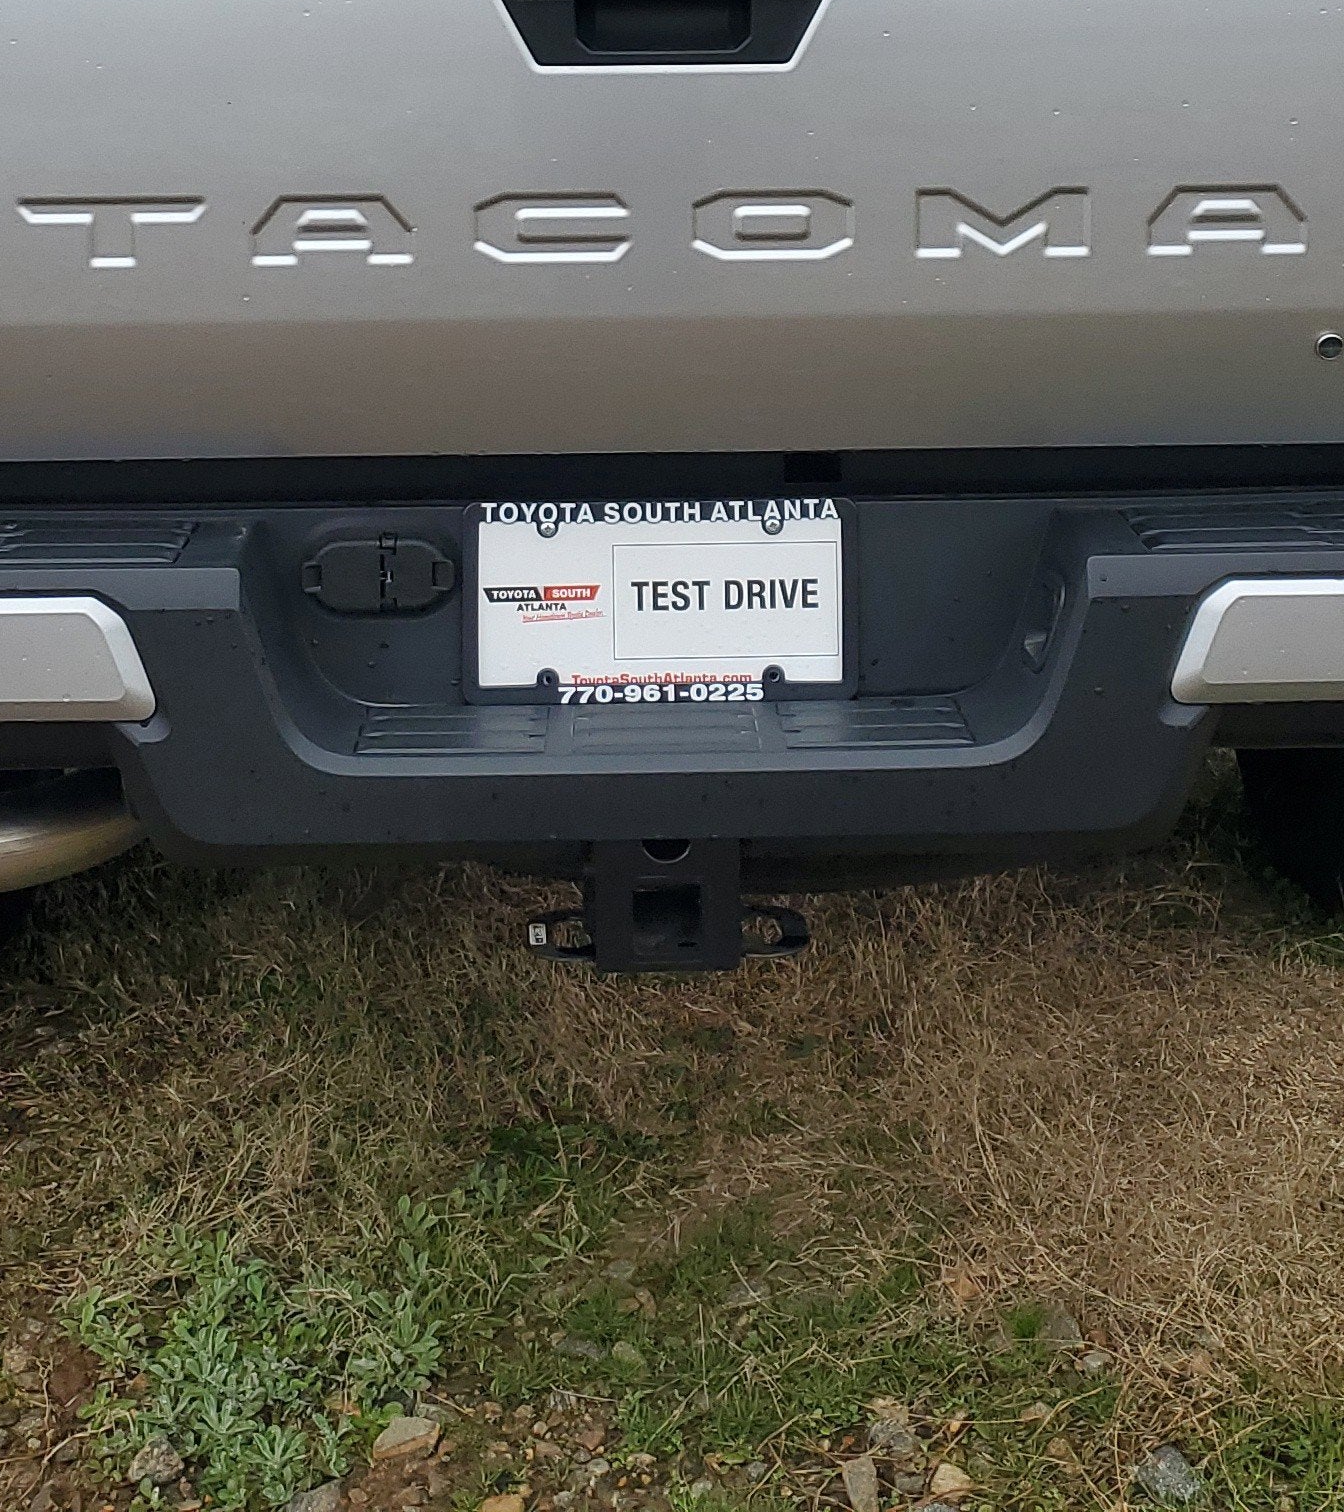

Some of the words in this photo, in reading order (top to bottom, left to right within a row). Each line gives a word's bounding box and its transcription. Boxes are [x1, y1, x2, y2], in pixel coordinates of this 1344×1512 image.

[16, 182, 1308, 267] TACOMA
[481, 502, 595, 524] TOYOTA
[604, 501, 701, 523] SOUTH
[711, 498, 839, 521] ATLANTA
[492, 590, 536, 599] TOYOTA
[552, 589, 591, 598] SOUTH
[631, 580, 711, 611] TEST
[724, 578, 819, 609] DRIVE
[517, 602, 567, 611] ATLANTA
[558, 683, 764, 704] 770-961-0225
